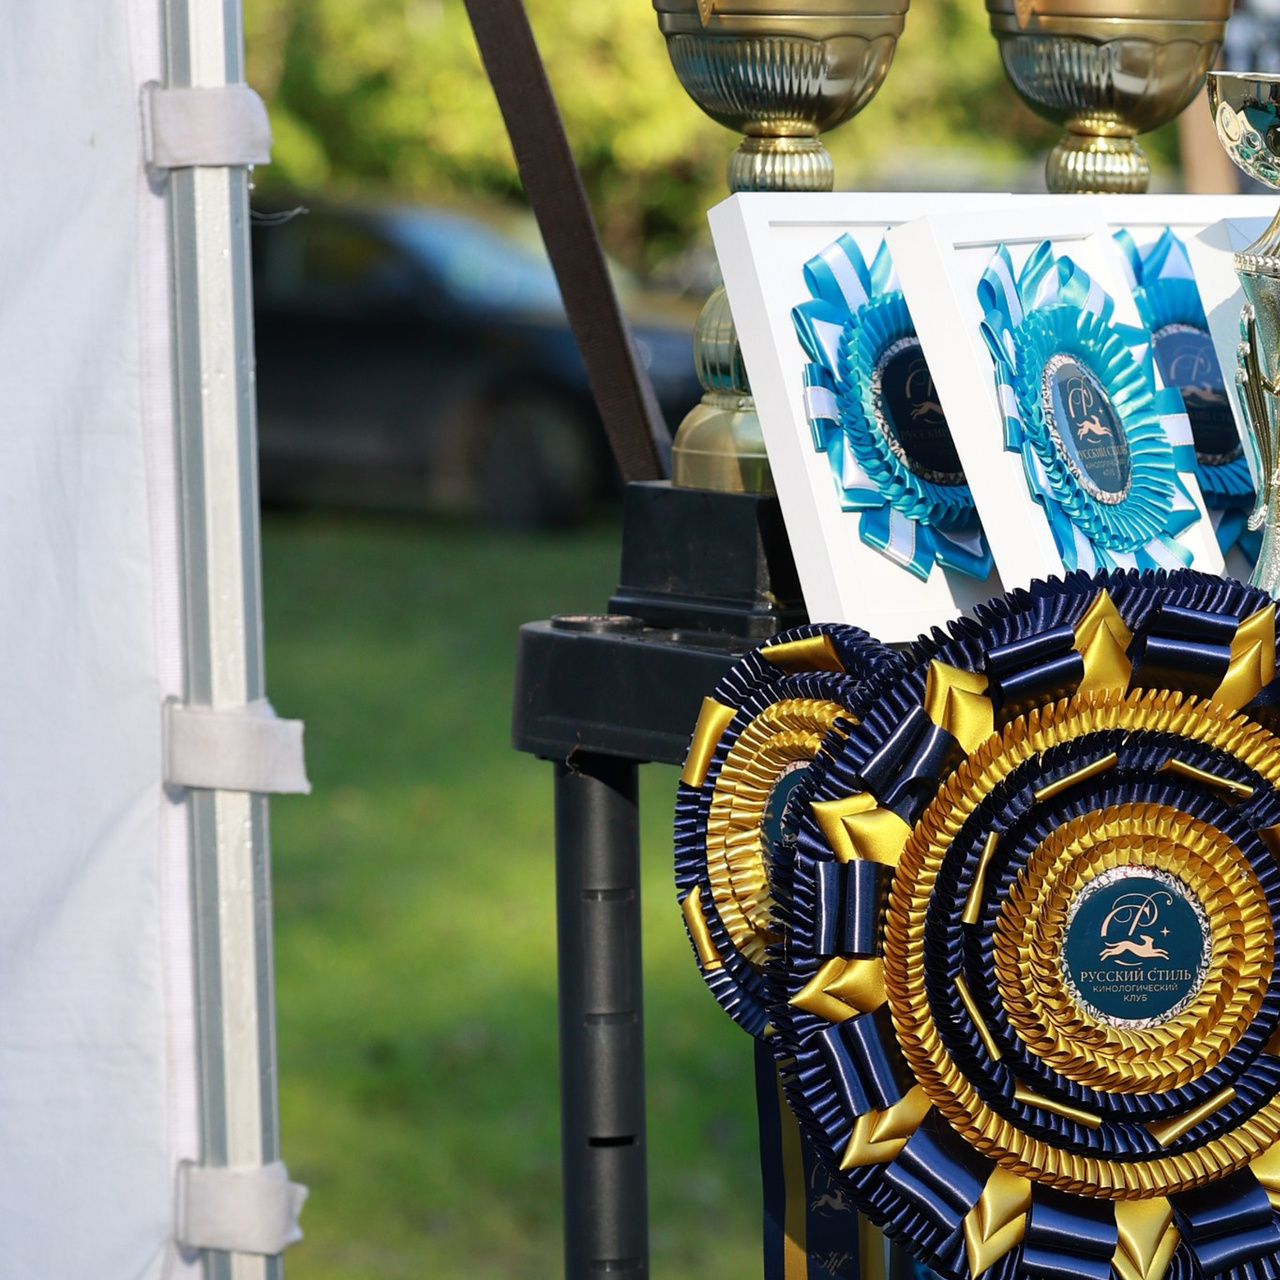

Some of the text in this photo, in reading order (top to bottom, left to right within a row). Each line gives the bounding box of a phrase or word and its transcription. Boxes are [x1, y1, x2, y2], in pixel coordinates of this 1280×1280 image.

[1080, 968, 1192, 983] РУССКИЙ СТИЛЬ
[1092, 983, 1178, 993] КИНОЛОГИЧЕСКИЙ
[1123, 994, 1148, 1002] КЛУБ
